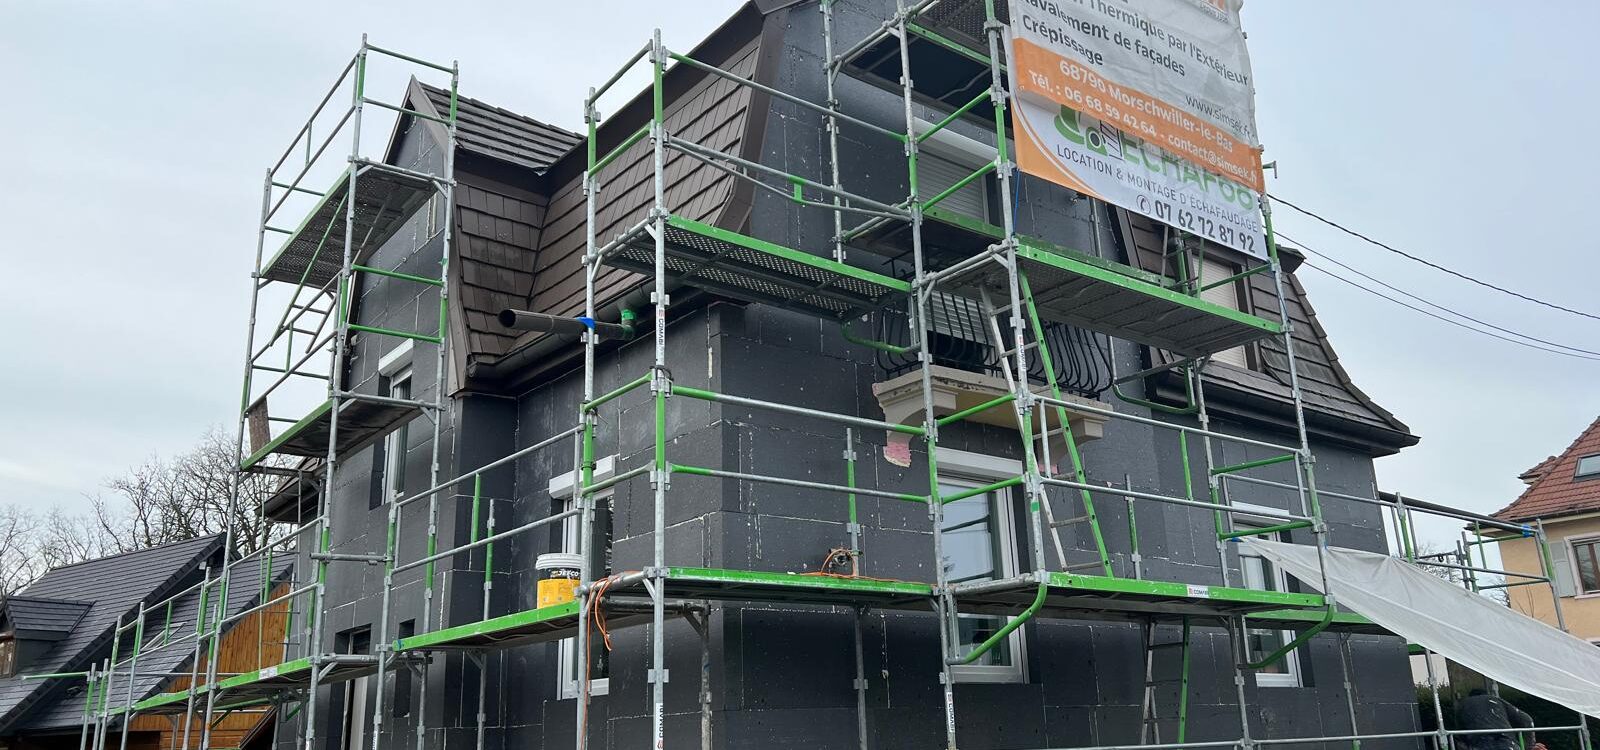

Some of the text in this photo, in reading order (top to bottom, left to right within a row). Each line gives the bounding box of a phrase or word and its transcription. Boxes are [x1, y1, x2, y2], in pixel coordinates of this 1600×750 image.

[1022, 14, 1103, 65] Crépissage
[1024, 0, 1185, 76] avalement de façades
[1167, 33, 1187, 53] par
[1189, 42, 1248, 85] l'Extérieur
[1060, 60, 1233, 153] 68790 Morschwiller-le-Bas
[1064, 86, 1083, 103] 06
[1085, 95, 1102, 112] 68
[1104, 103, 1120, 120] 59
[1057, 144, 1258, 233] LOCATION & MONTAGE D'ÉCHAFAUDAGE
[1155, 200, 1256, 253] 07 62 72 87 92
